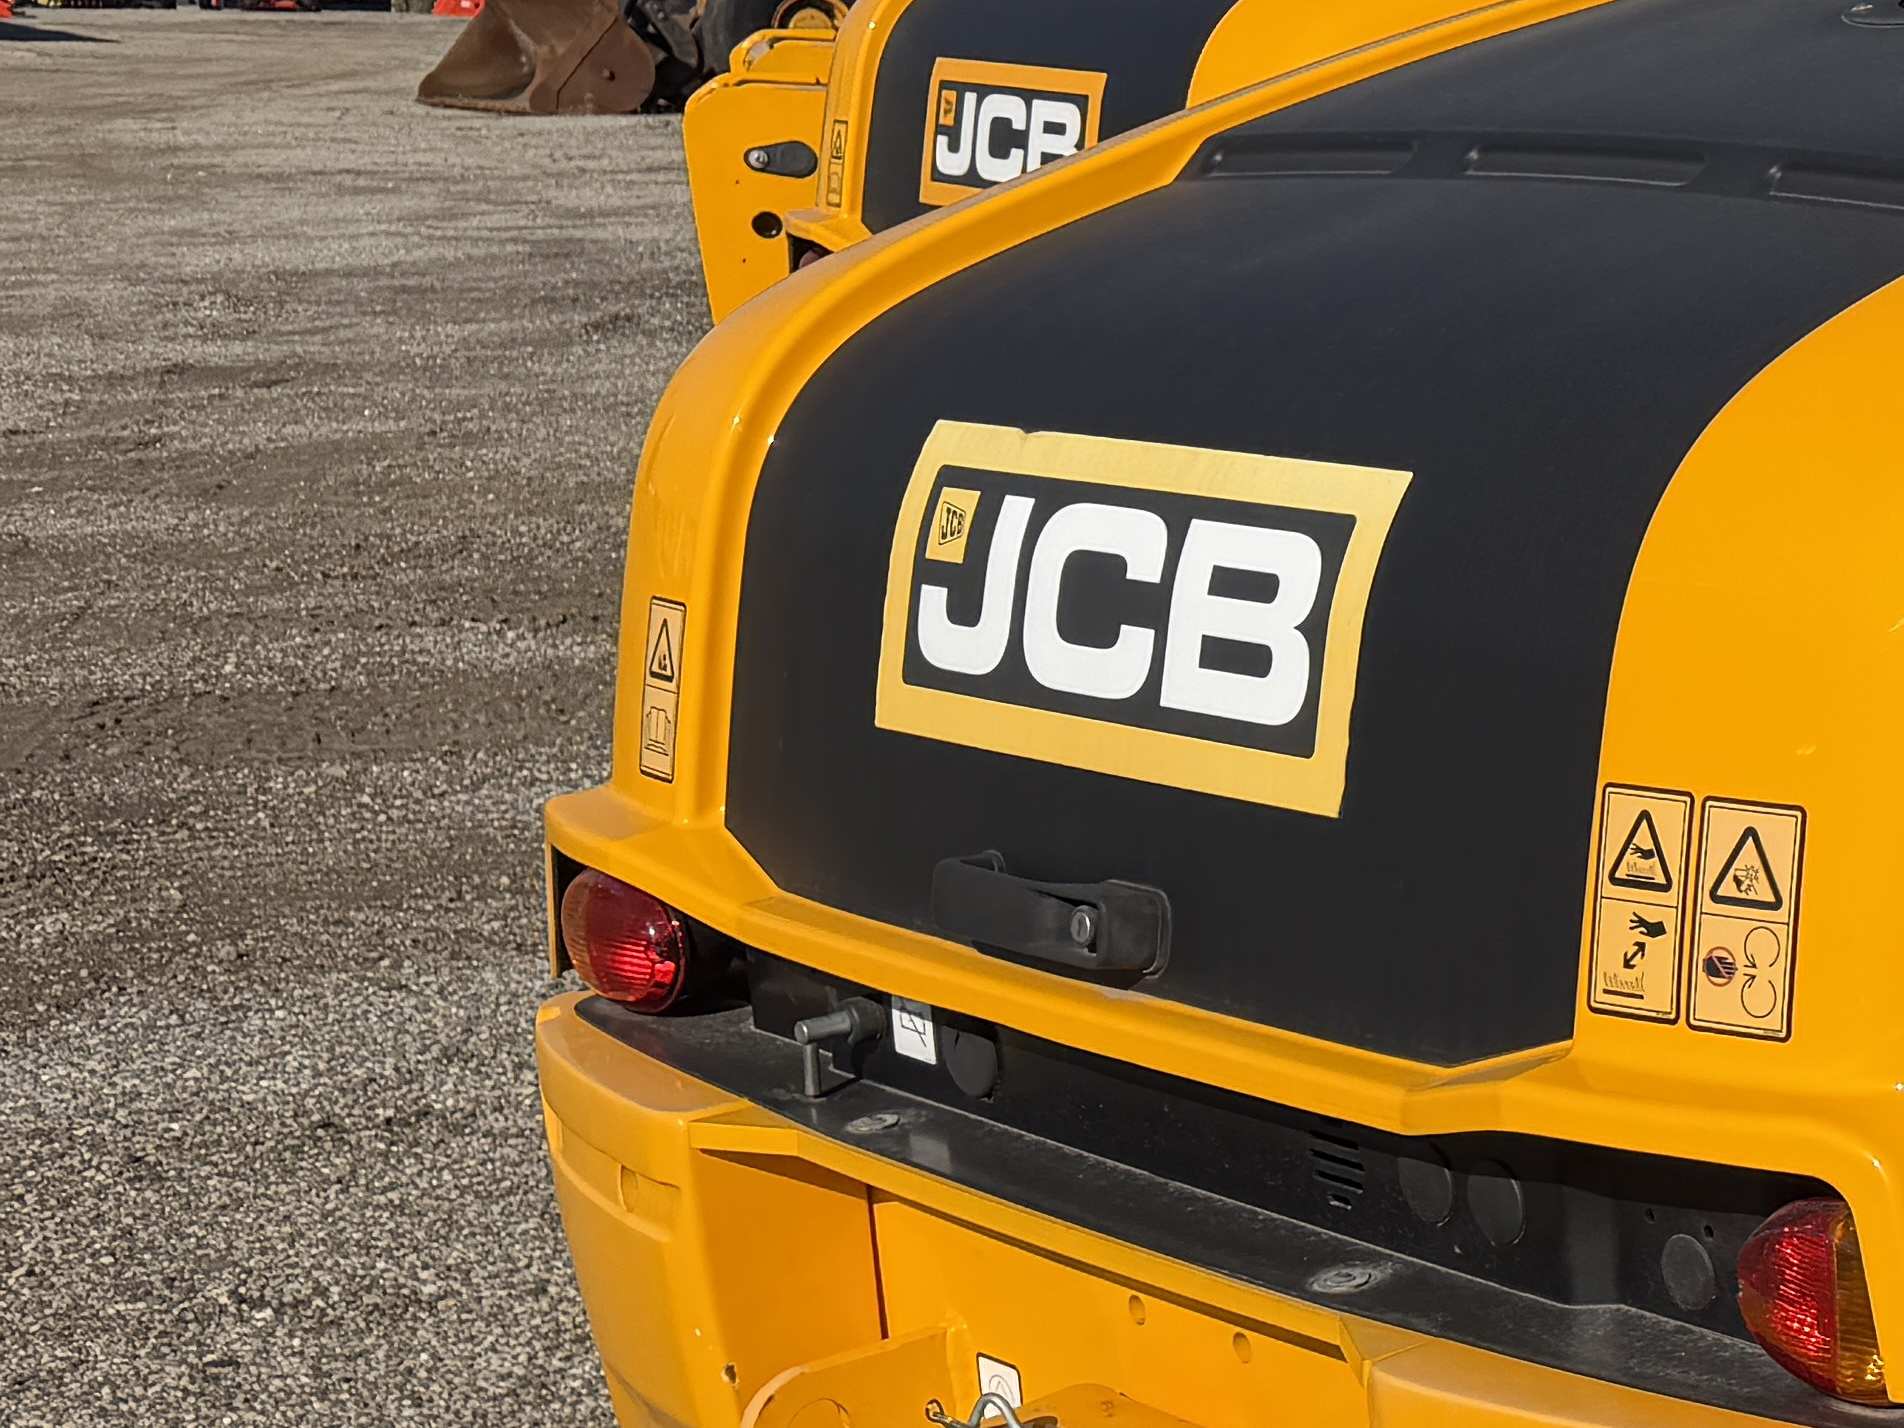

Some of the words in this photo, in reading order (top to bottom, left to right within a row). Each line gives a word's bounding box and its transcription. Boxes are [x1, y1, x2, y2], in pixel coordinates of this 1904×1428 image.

[935, 90, 1081, 183] JCB
[941, 506, 965, 540] JCB
[917, 494, 1323, 726] JCB
